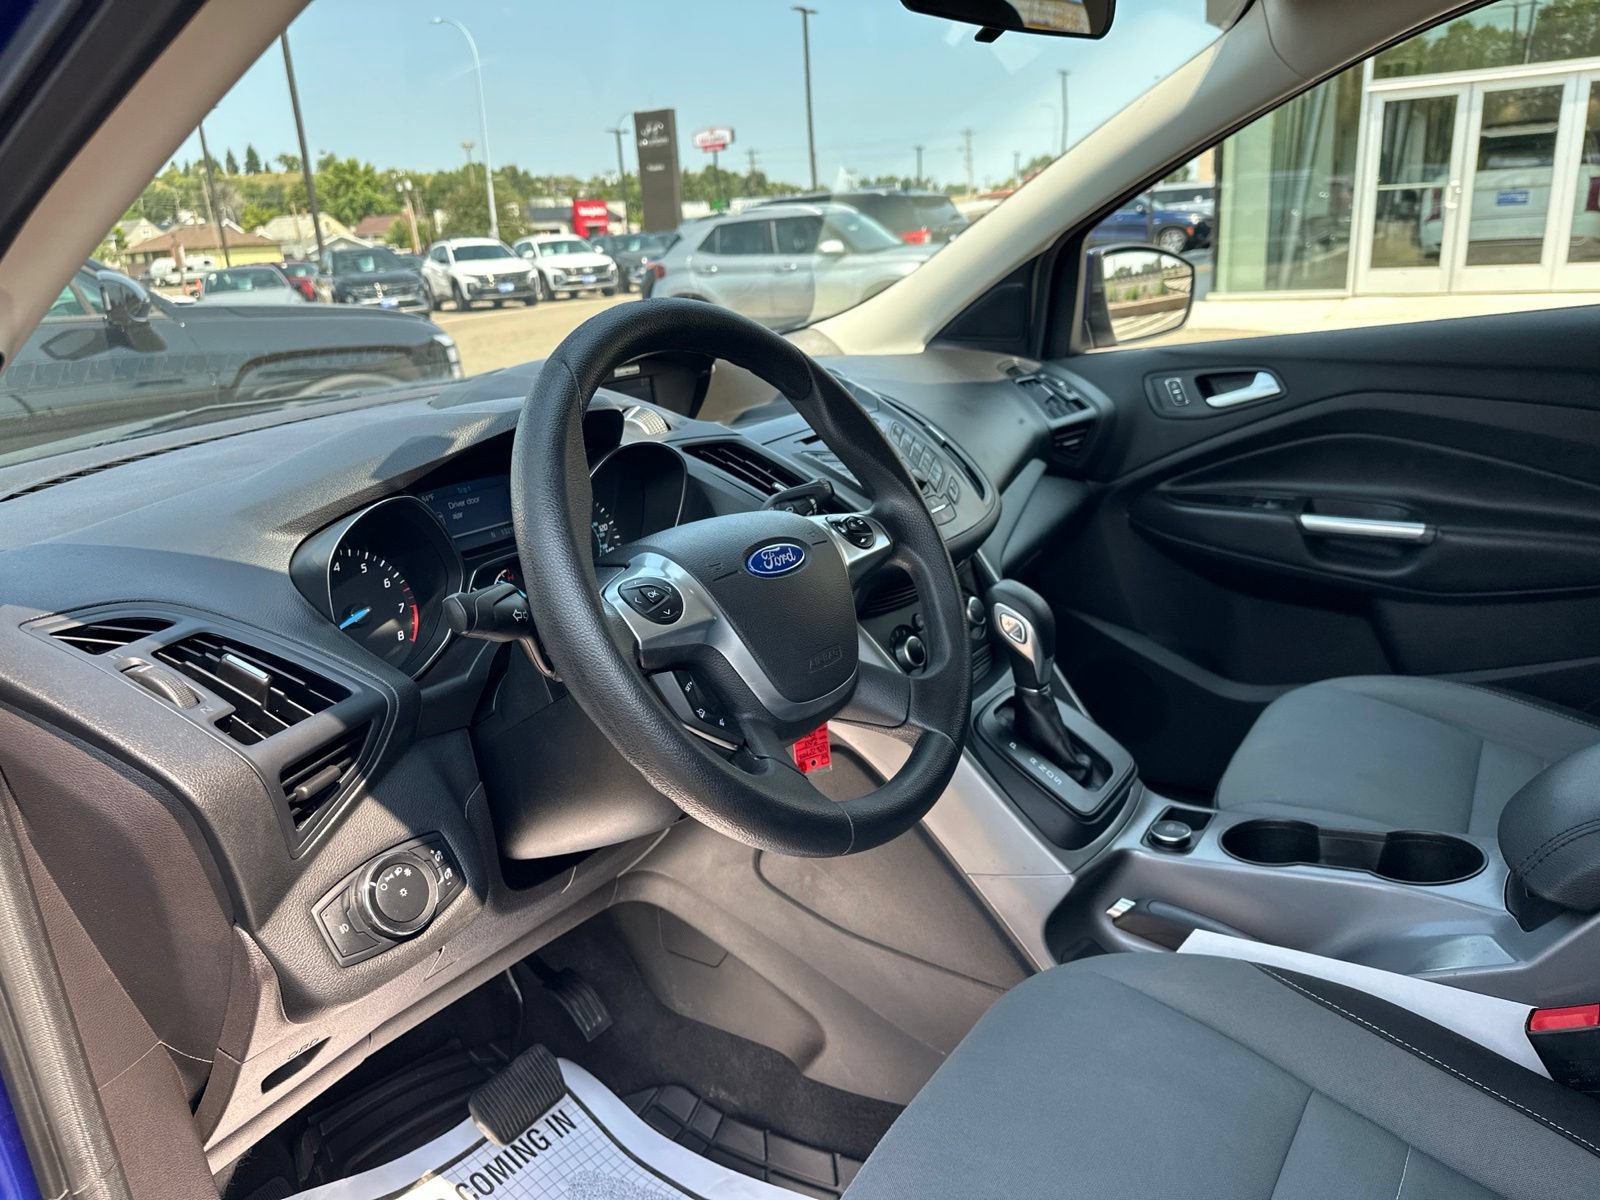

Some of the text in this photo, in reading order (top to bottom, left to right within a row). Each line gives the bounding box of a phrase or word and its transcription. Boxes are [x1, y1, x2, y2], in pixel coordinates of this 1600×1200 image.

[447, 496, 480, 510] Driver door
[761, 546, 796, 570] Ford
[333, 561, 341, 572] 4
[360, 562, 368, 574] 5
[383, 577, 391, 588] 6
[647, 589, 660, 598] OK
[398, 602, 405, 613] 7
[397, 630, 405, 641] 8
[544, 1109, 577, 1138] IN
